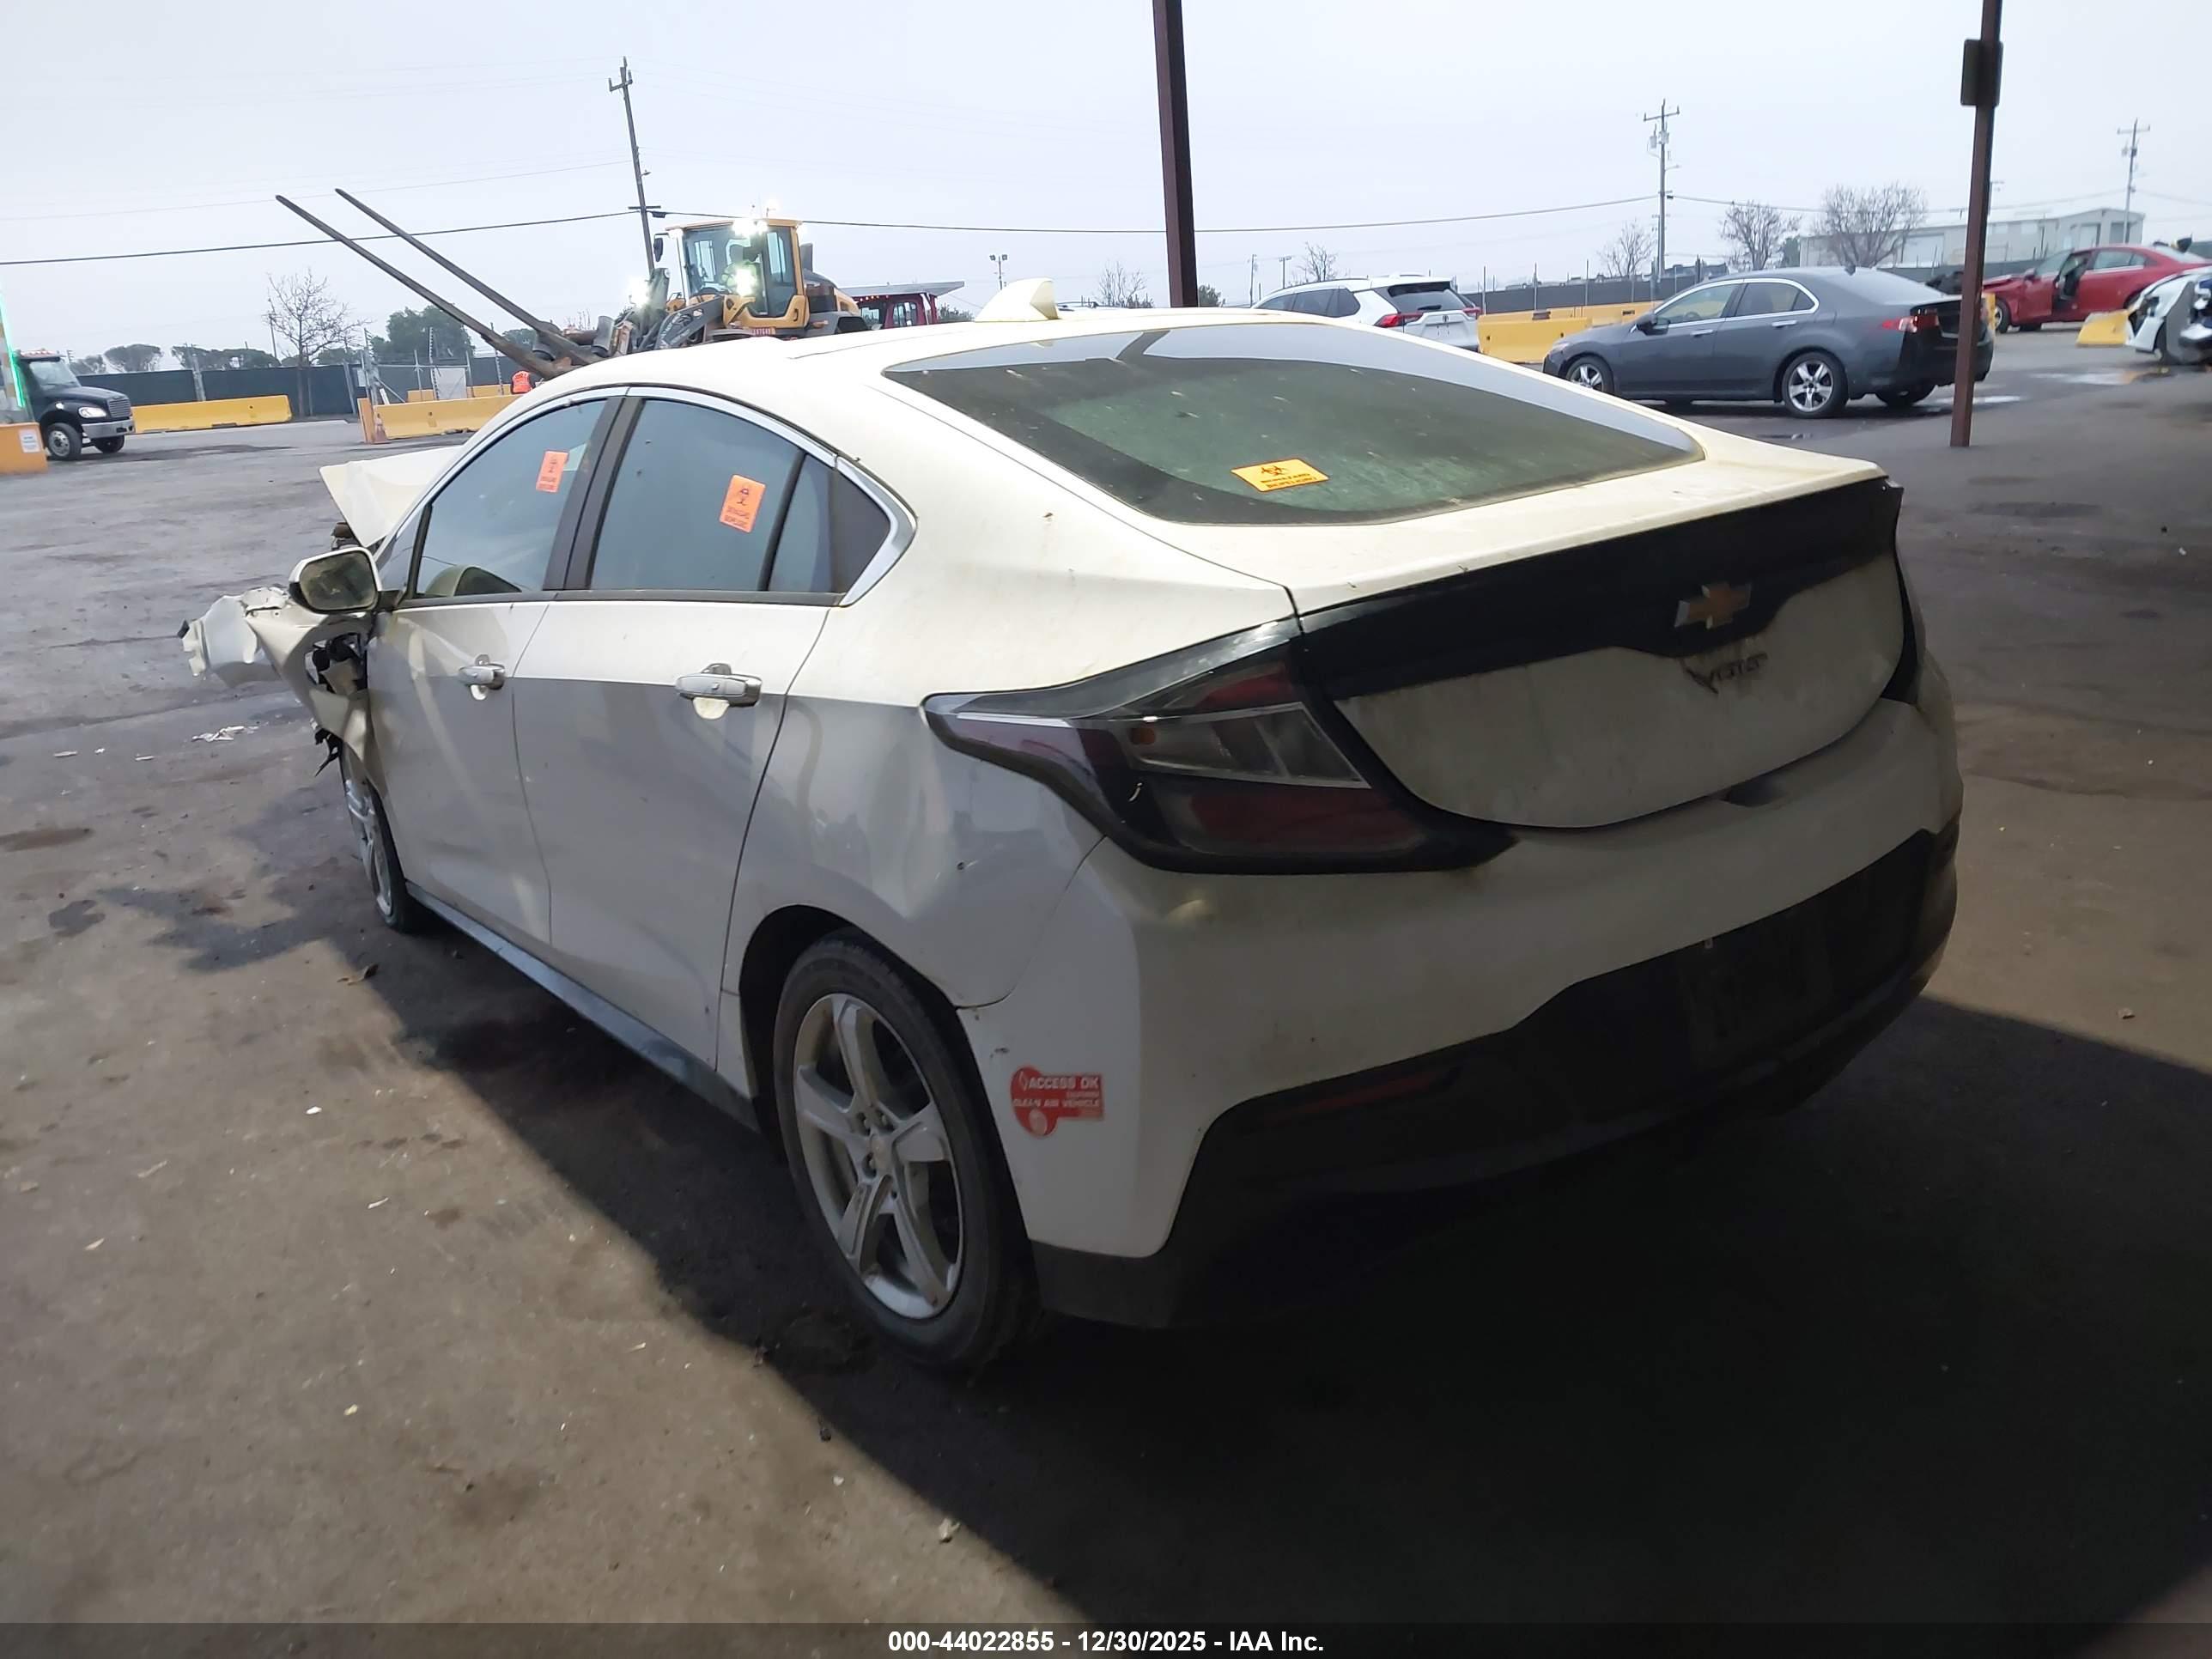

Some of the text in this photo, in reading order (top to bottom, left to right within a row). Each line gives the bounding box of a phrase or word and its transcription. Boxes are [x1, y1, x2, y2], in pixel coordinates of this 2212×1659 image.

[1028, 1076, 1099, 1091] ACCESS OK
[1012, 1098, 1042, 1108] CLEAN
